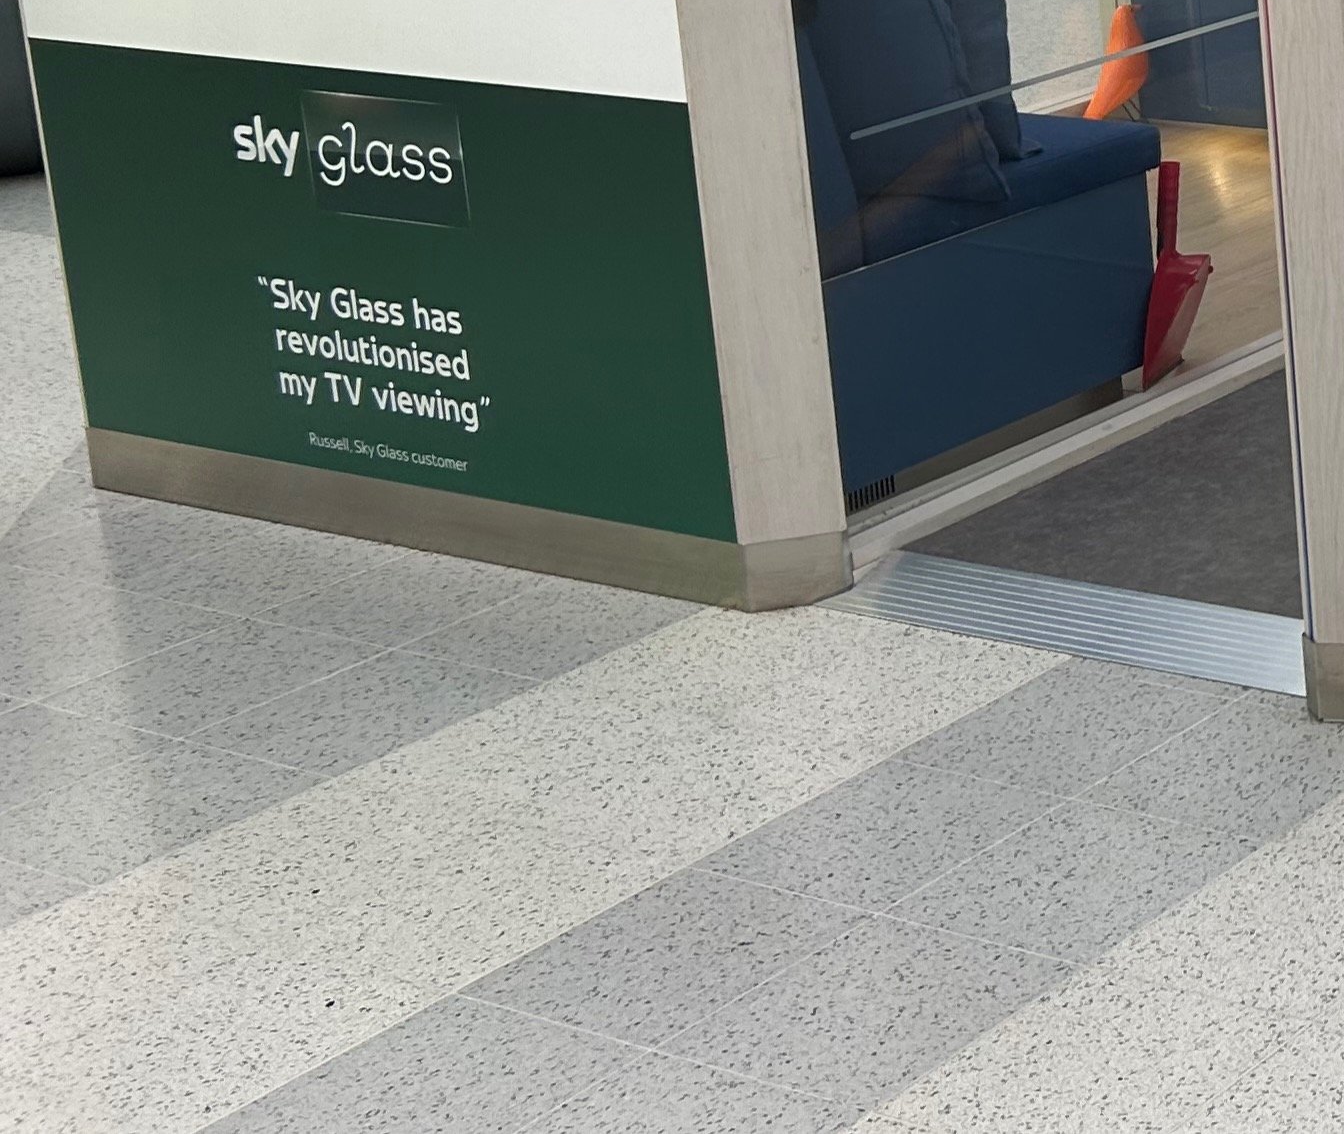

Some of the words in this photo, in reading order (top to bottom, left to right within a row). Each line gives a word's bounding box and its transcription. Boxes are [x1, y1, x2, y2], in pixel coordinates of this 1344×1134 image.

[234, 114, 300, 178] sky
[318, 122, 454, 188] glass
[330, 286, 405, 328] Glass
[412, 296, 463, 336] has
[275, 324, 470, 382] revolutionised
[279, 369, 316, 406] my
[325, 371, 363, 407] TV
[354, 437, 376, 459] Sky
[377, 441, 409, 462] Glass
[411, 448, 469, 472] customer
